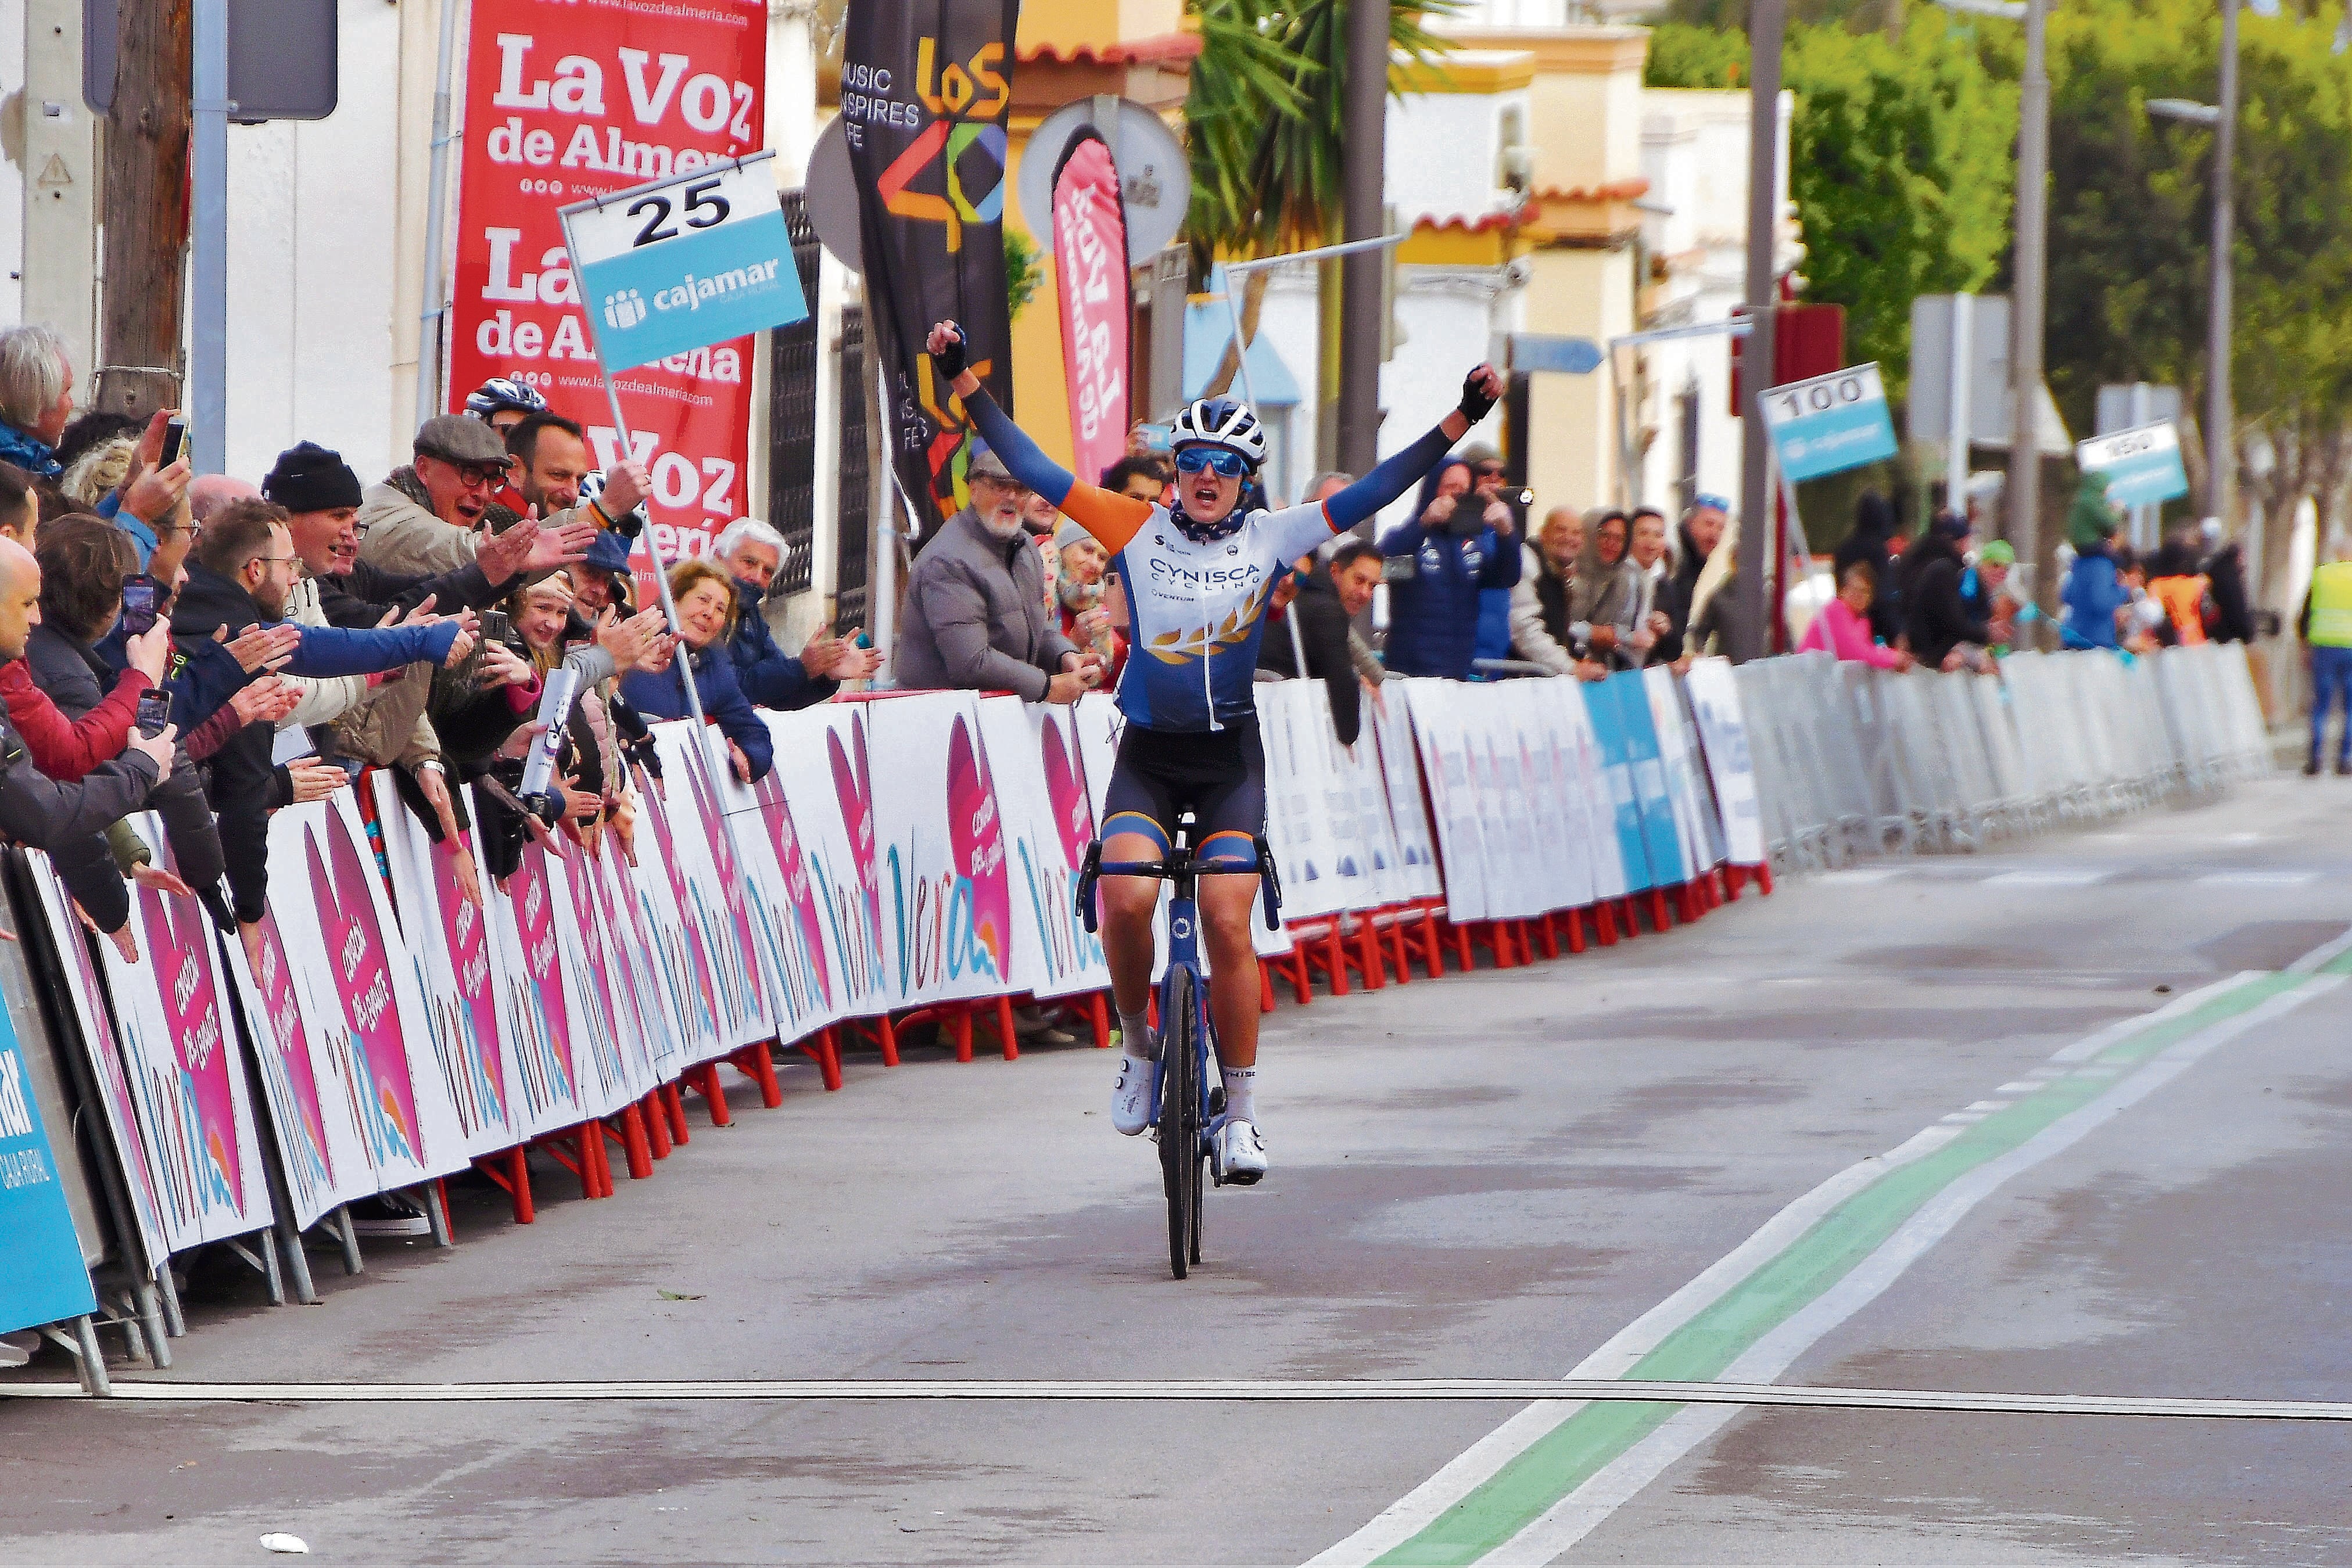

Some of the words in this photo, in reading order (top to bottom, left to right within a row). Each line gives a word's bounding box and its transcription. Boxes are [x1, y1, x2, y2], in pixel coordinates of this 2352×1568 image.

[493, 32, 605, 115] La
[618, 46, 754, 142] Voz
[487, 117, 554, 165] de
[627, 178, 730, 247] 25
[481, 227, 581, 304] La
[654, 257, 779, 310] cajamar
[476, 309, 544, 356] de
[558, 374, 713, 406] www.laozdealmeria.com
[1781, 378, 1861, 417] 100
[1150, 558, 1260, 583] CYNISCA
[1152, 573, 1260, 591] CYCLING
